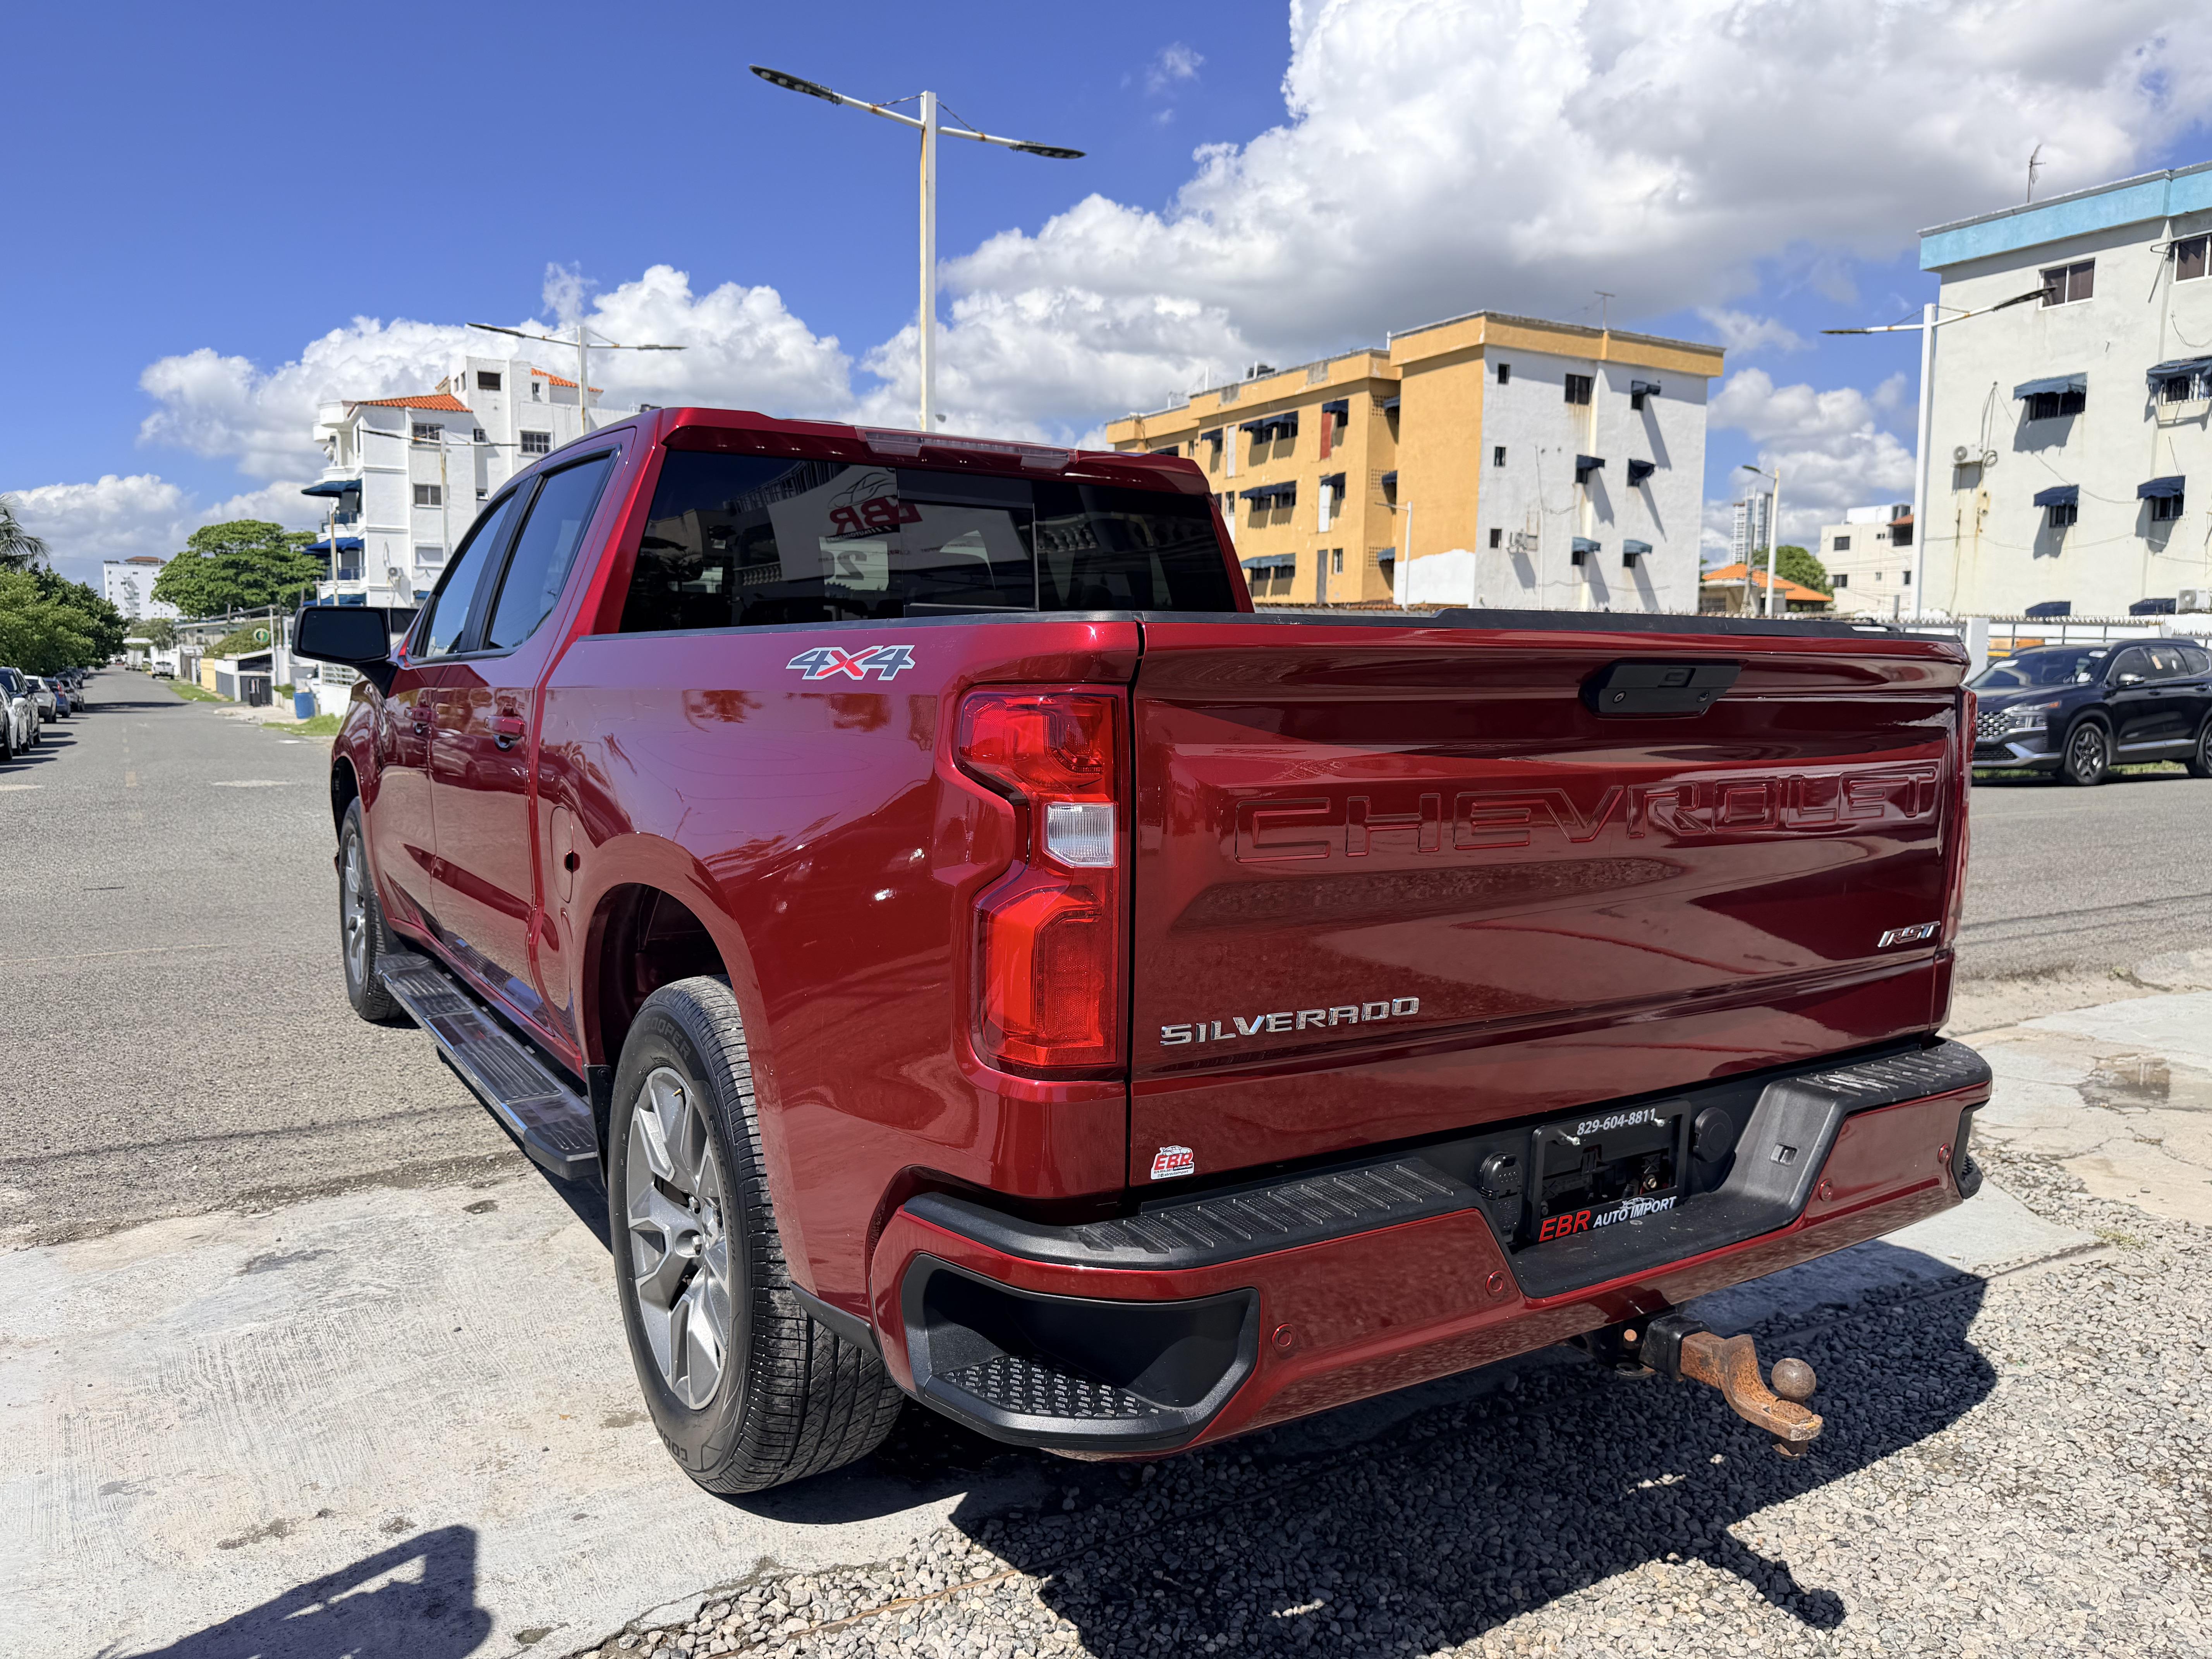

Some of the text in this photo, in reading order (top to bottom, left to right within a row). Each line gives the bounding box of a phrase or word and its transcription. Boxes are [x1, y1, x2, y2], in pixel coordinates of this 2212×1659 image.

[1234, 766, 1937, 864] CHEVROLET
[644, 1017, 691, 1060] COOPER
[1160, 996, 1420, 1046] SILVERADO
[1577, 1108, 1656, 1136] 829-604-8811
[1154, 1152, 1192, 1170] EBR
[1539, 1196, 1677, 1242] EBR AUTO IMPORT
